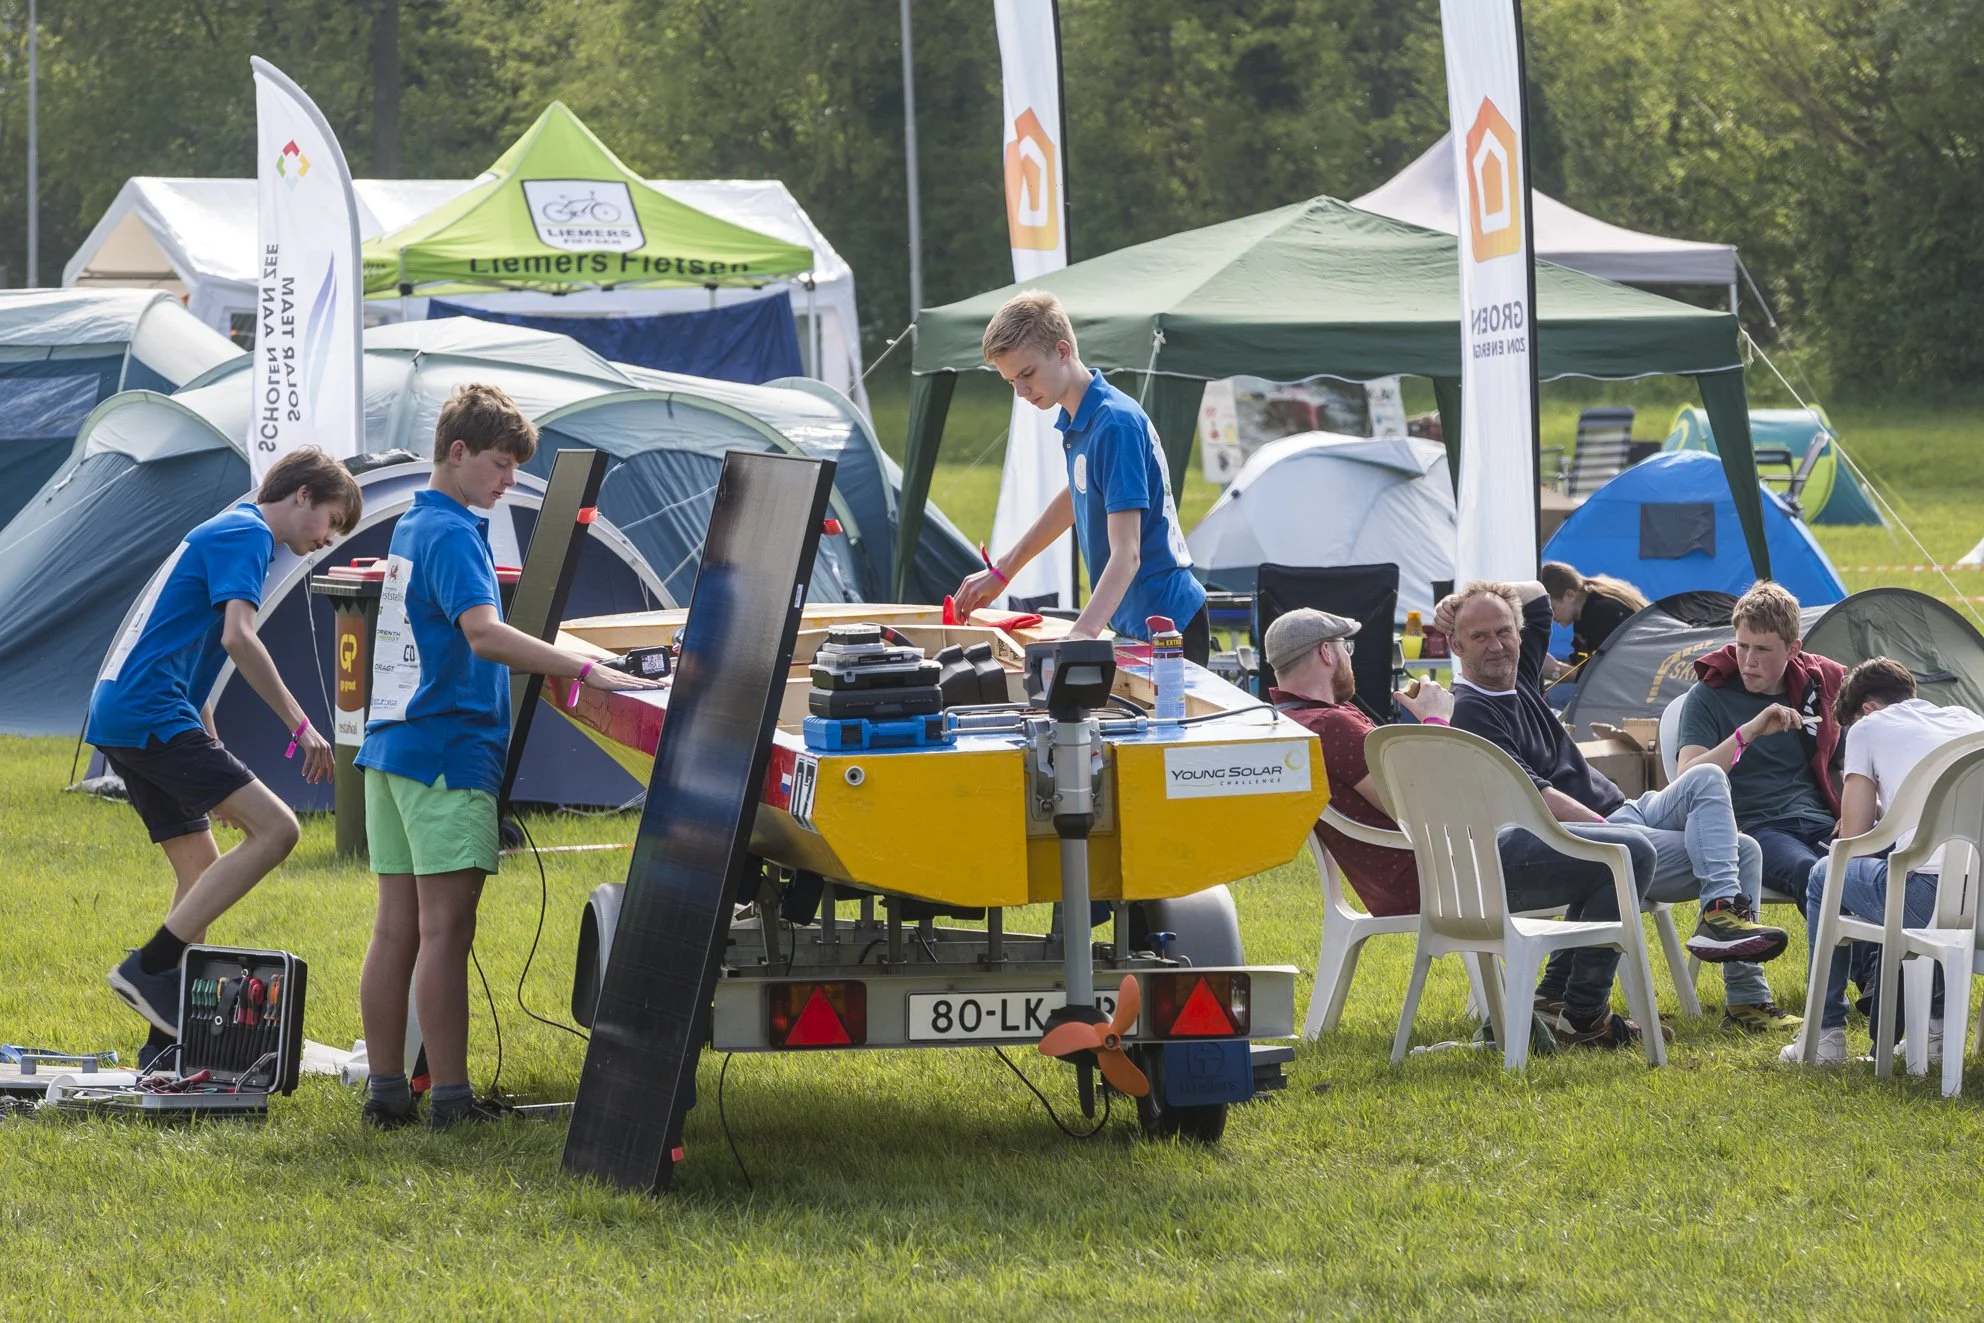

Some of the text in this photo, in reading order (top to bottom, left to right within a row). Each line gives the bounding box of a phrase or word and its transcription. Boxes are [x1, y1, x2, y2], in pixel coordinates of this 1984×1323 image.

[547, 228, 632, 238] LIEMERS
[469, 253, 608, 274] Liemers
[1171, 766, 1283, 781] YOUNG SOLAR
[1219, 778, 1282, 786] CHALLENGE
